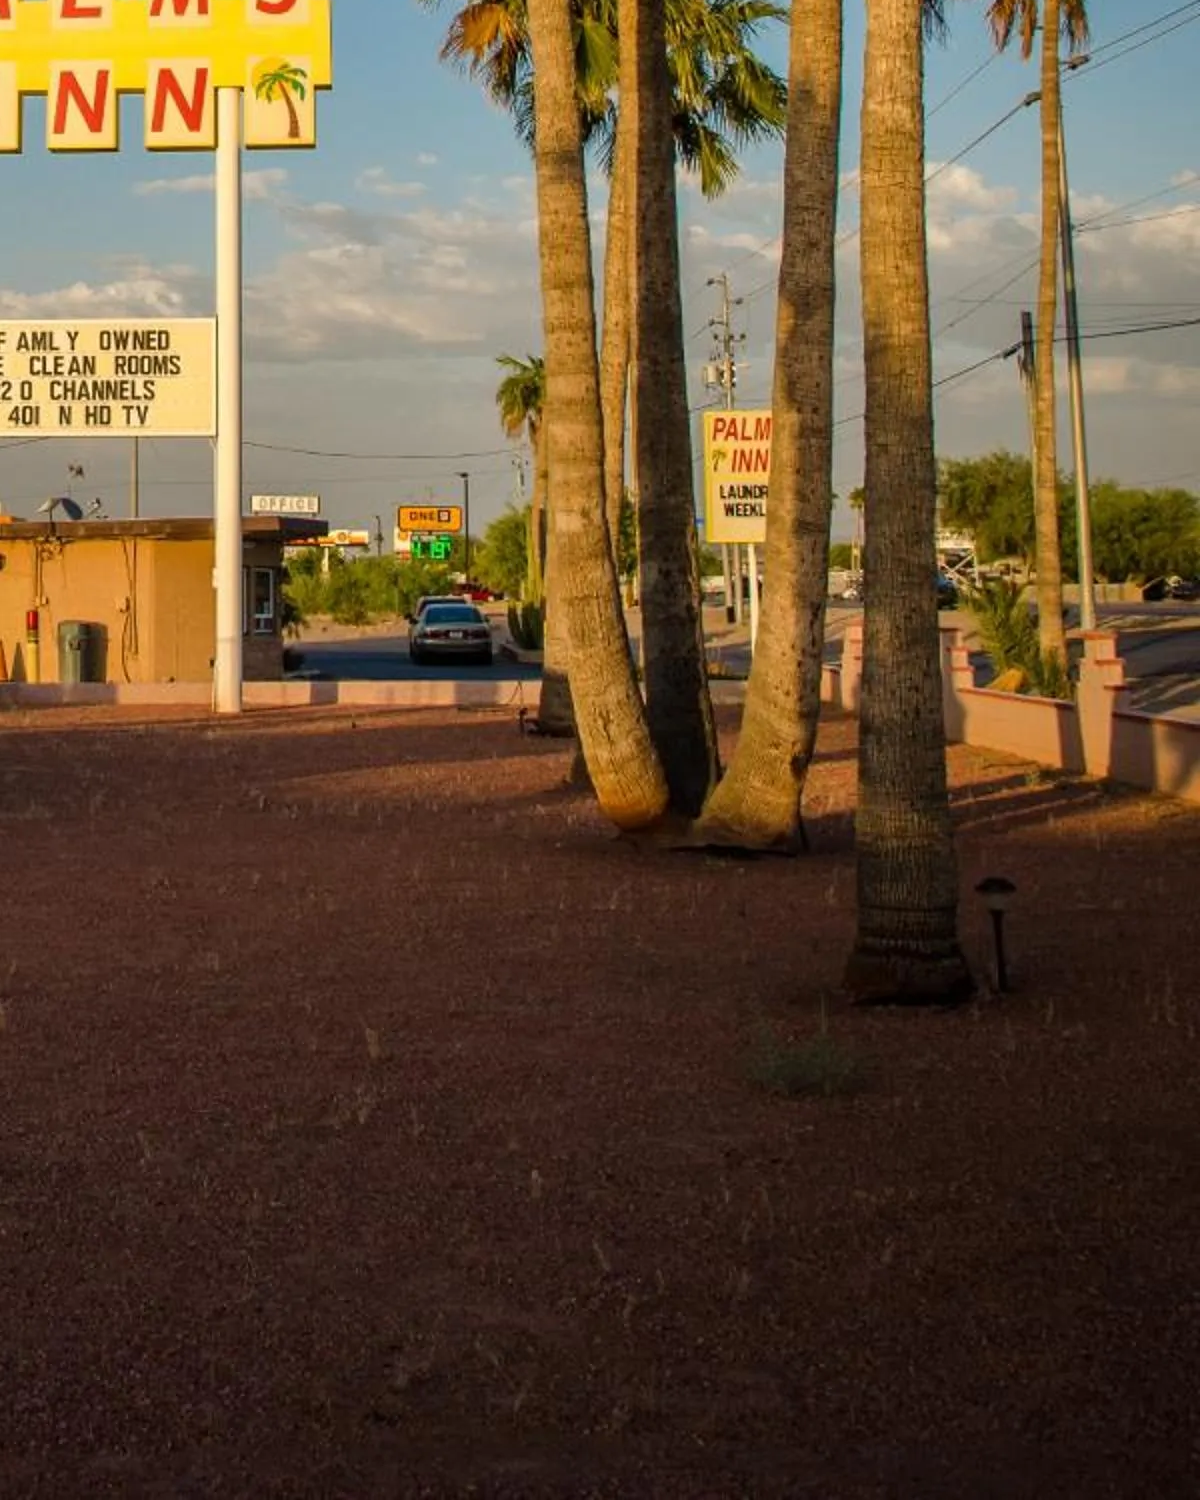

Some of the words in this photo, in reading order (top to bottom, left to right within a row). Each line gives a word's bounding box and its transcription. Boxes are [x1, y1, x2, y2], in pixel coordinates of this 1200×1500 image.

[100, 330, 170, 351] OWNED
[29, 356, 96, 376] CLEAN
[114, 355, 181, 376] ROOMS
[49, 380, 156, 401] CHANNELS
[85, 405, 111, 425] HD
[122, 405, 149, 425] TV
[731, 448, 769, 473] INN
[259, 497, 316, 511] OFFICE
